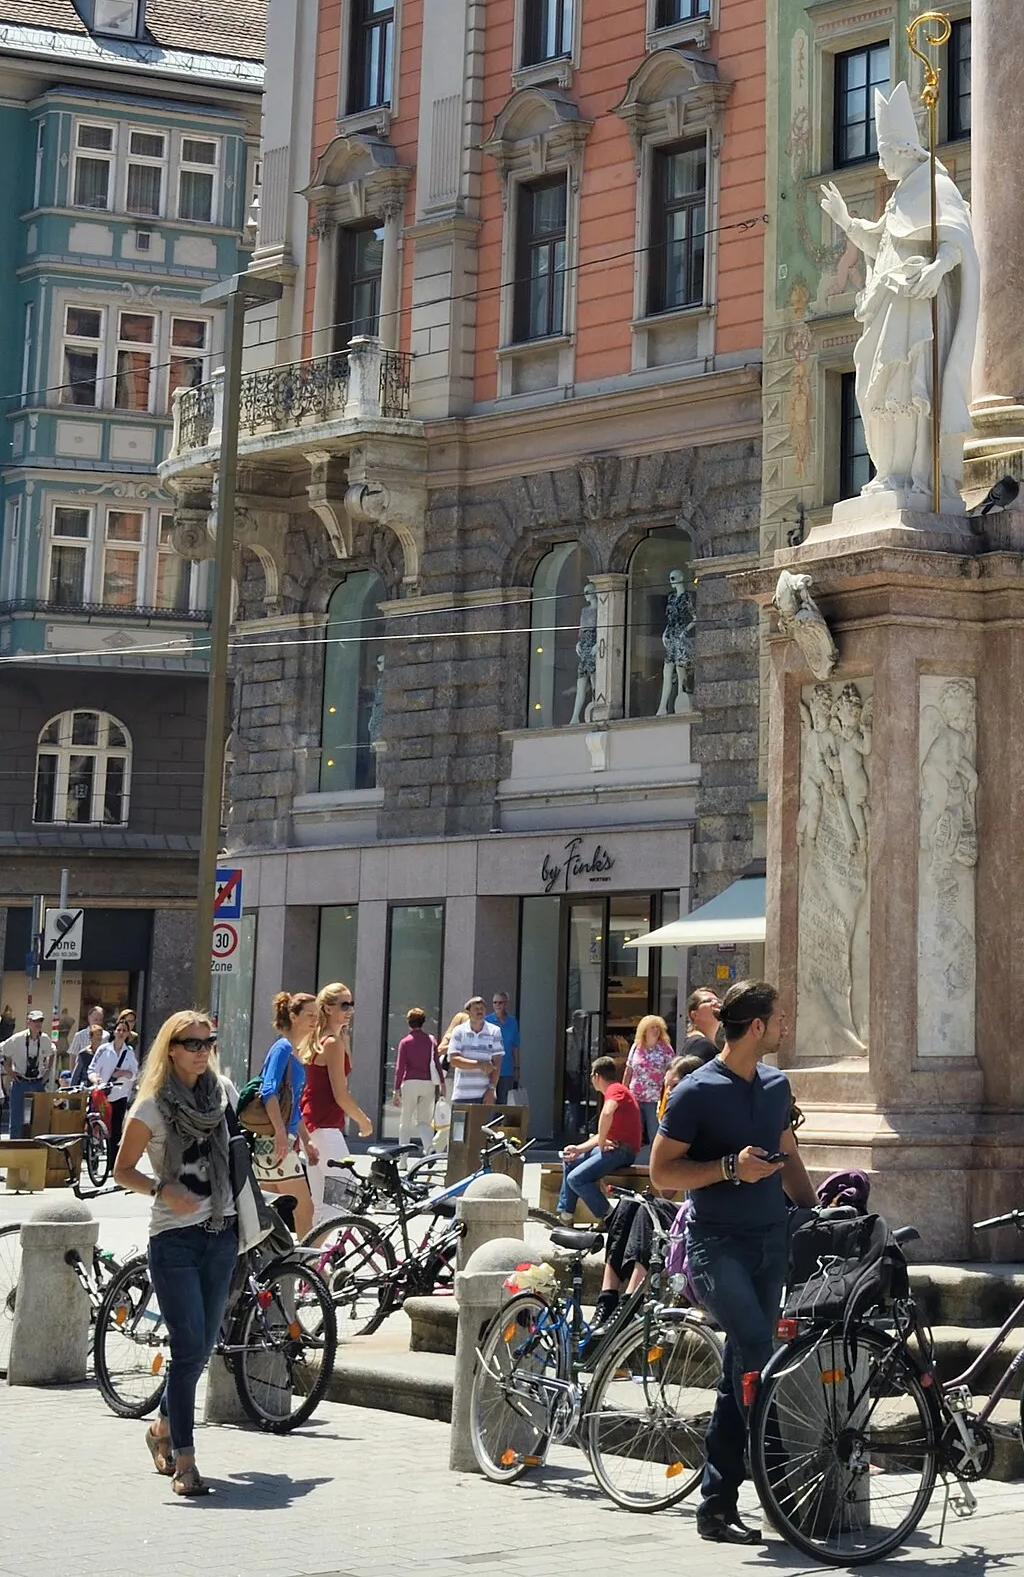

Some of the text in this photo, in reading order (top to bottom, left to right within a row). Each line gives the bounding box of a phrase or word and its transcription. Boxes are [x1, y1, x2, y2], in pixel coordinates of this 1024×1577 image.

[541, 837, 616, 893] by Fink's
[215, 933, 229, 948] 30
[211, 961, 232, 972] Zone
